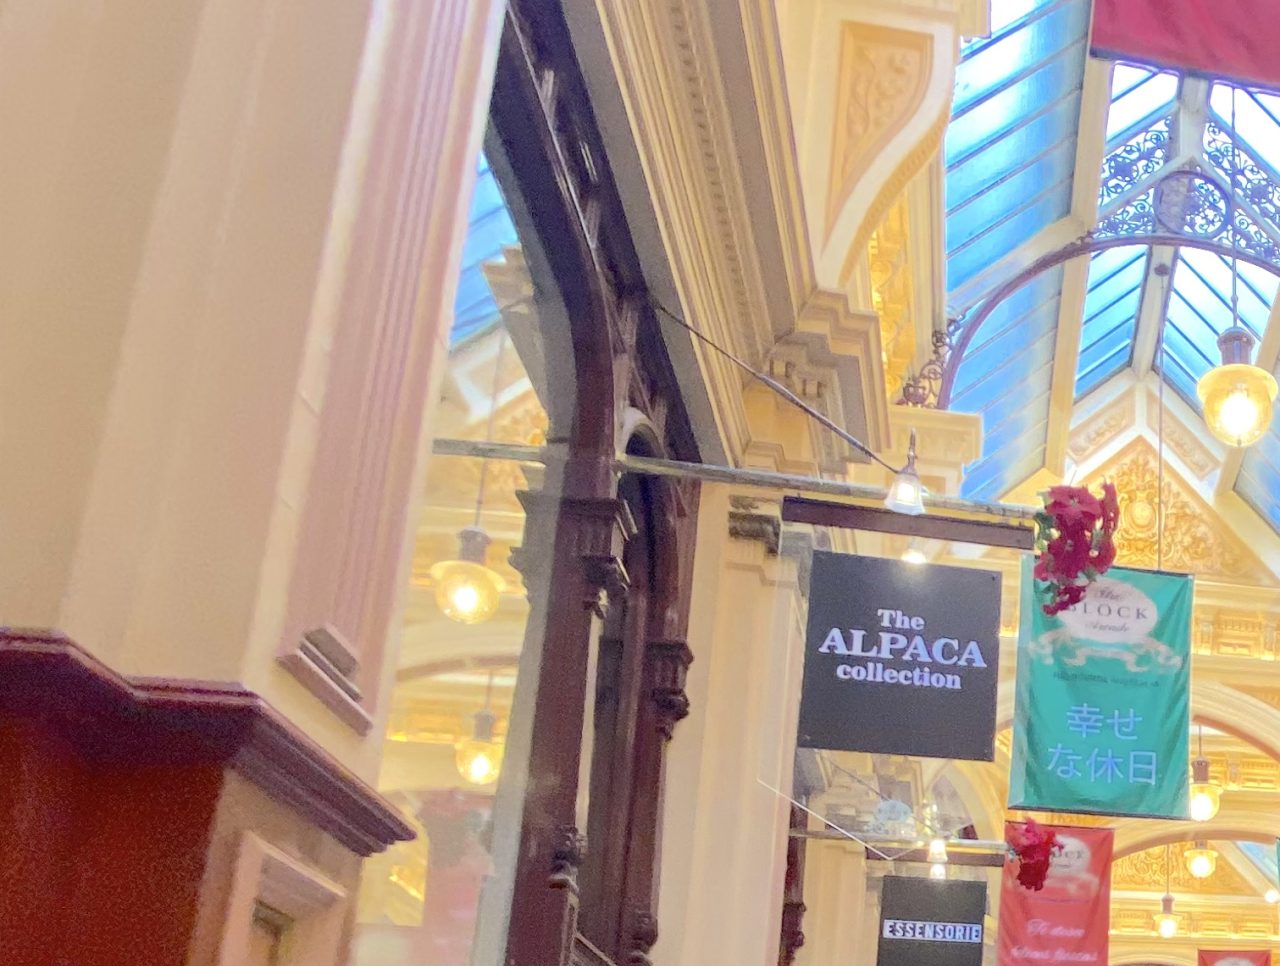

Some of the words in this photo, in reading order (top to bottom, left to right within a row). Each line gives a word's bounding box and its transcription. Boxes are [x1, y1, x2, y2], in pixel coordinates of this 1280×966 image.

[878, 609, 925, 631] The
[818, 628, 987, 668] ALPACA
[836, 661, 962, 690] collection
[1066, 703, 1143, 741] 幸せ
[1048, 743, 1158, 786] な休日
[886, 921, 980, 942] ESSENSORIE
